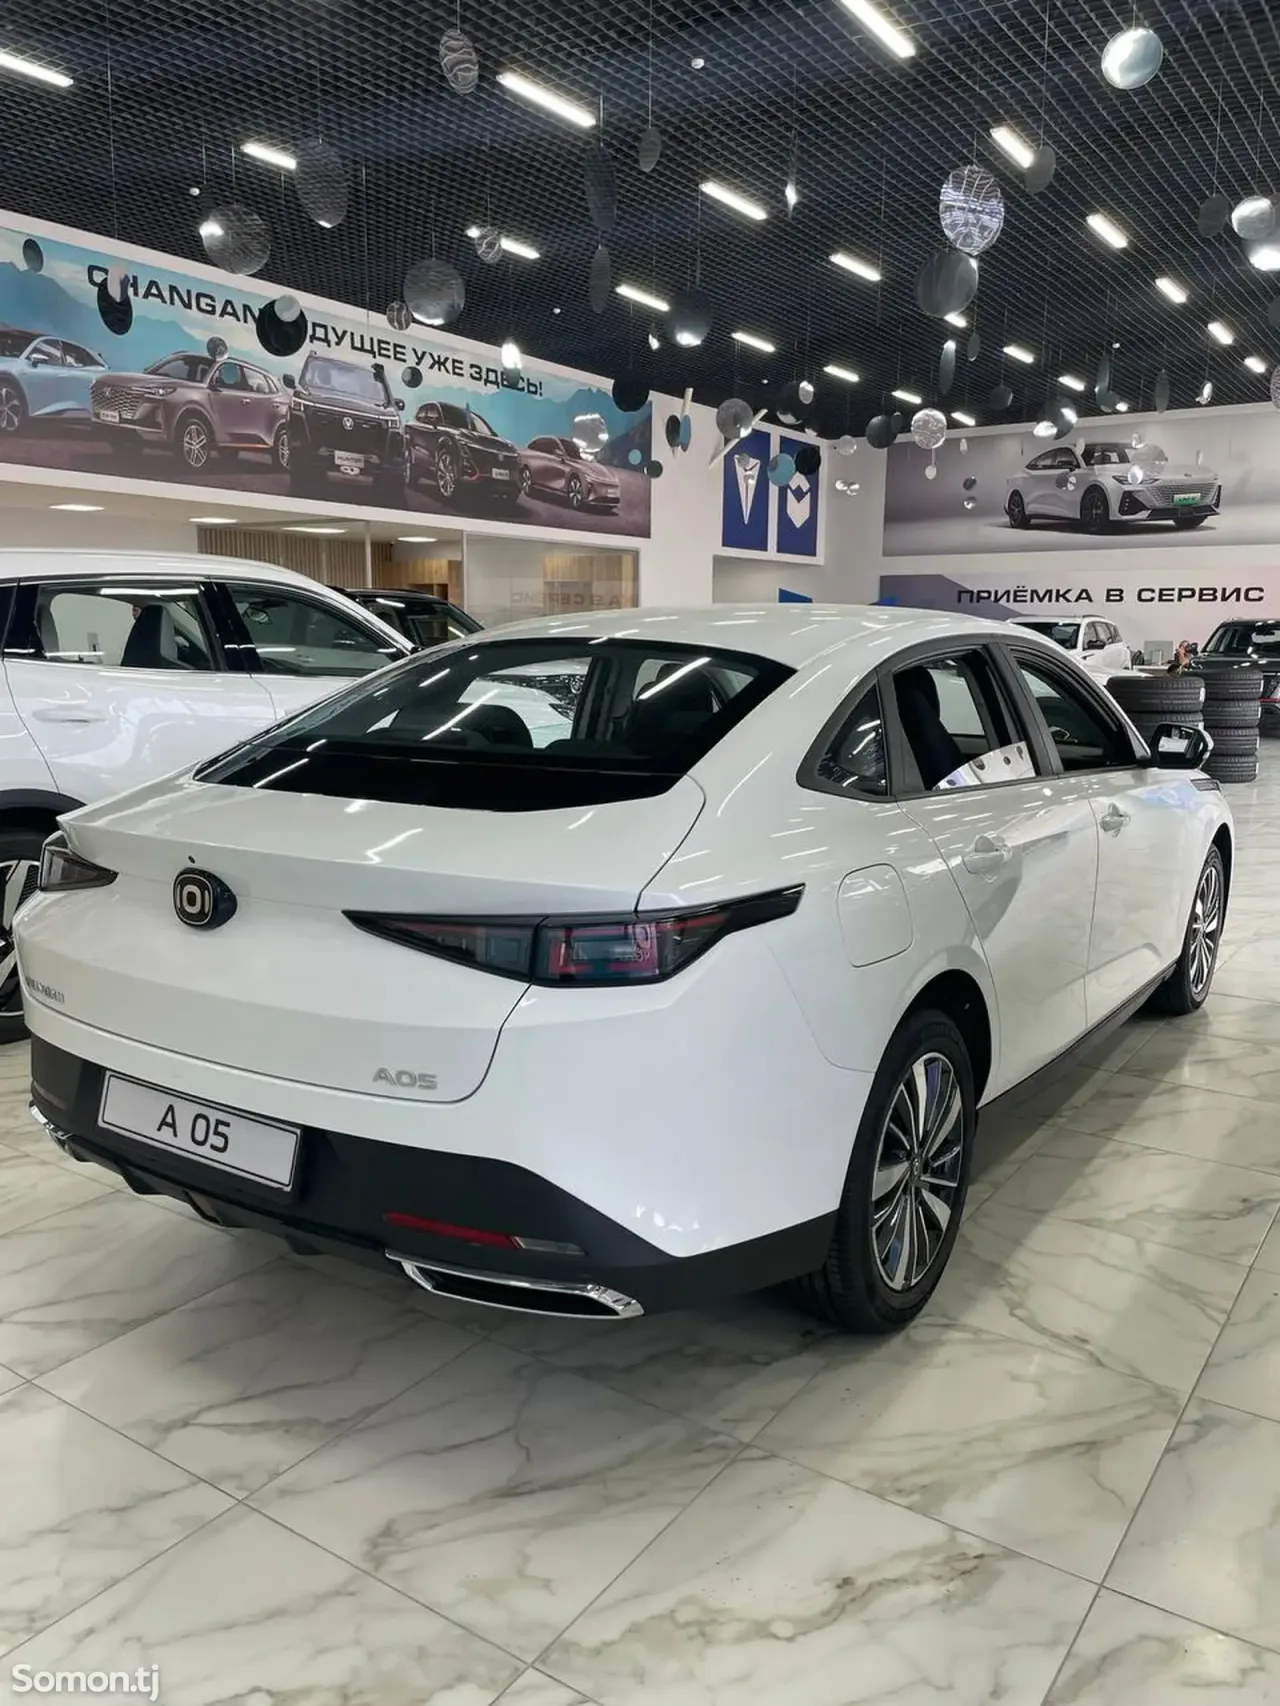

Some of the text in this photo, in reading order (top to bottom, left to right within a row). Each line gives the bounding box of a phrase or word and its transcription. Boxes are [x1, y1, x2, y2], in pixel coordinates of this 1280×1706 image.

[309, 321, 407, 366] ДУЩЕЕ
[412, 347, 465, 378] УЖЕ
[957, 585, 1265, 603] ПРИЁМКА В СЕРВИС
[372, 1067, 438, 1090] A05
[156, 1104, 231, 1153] A 05
